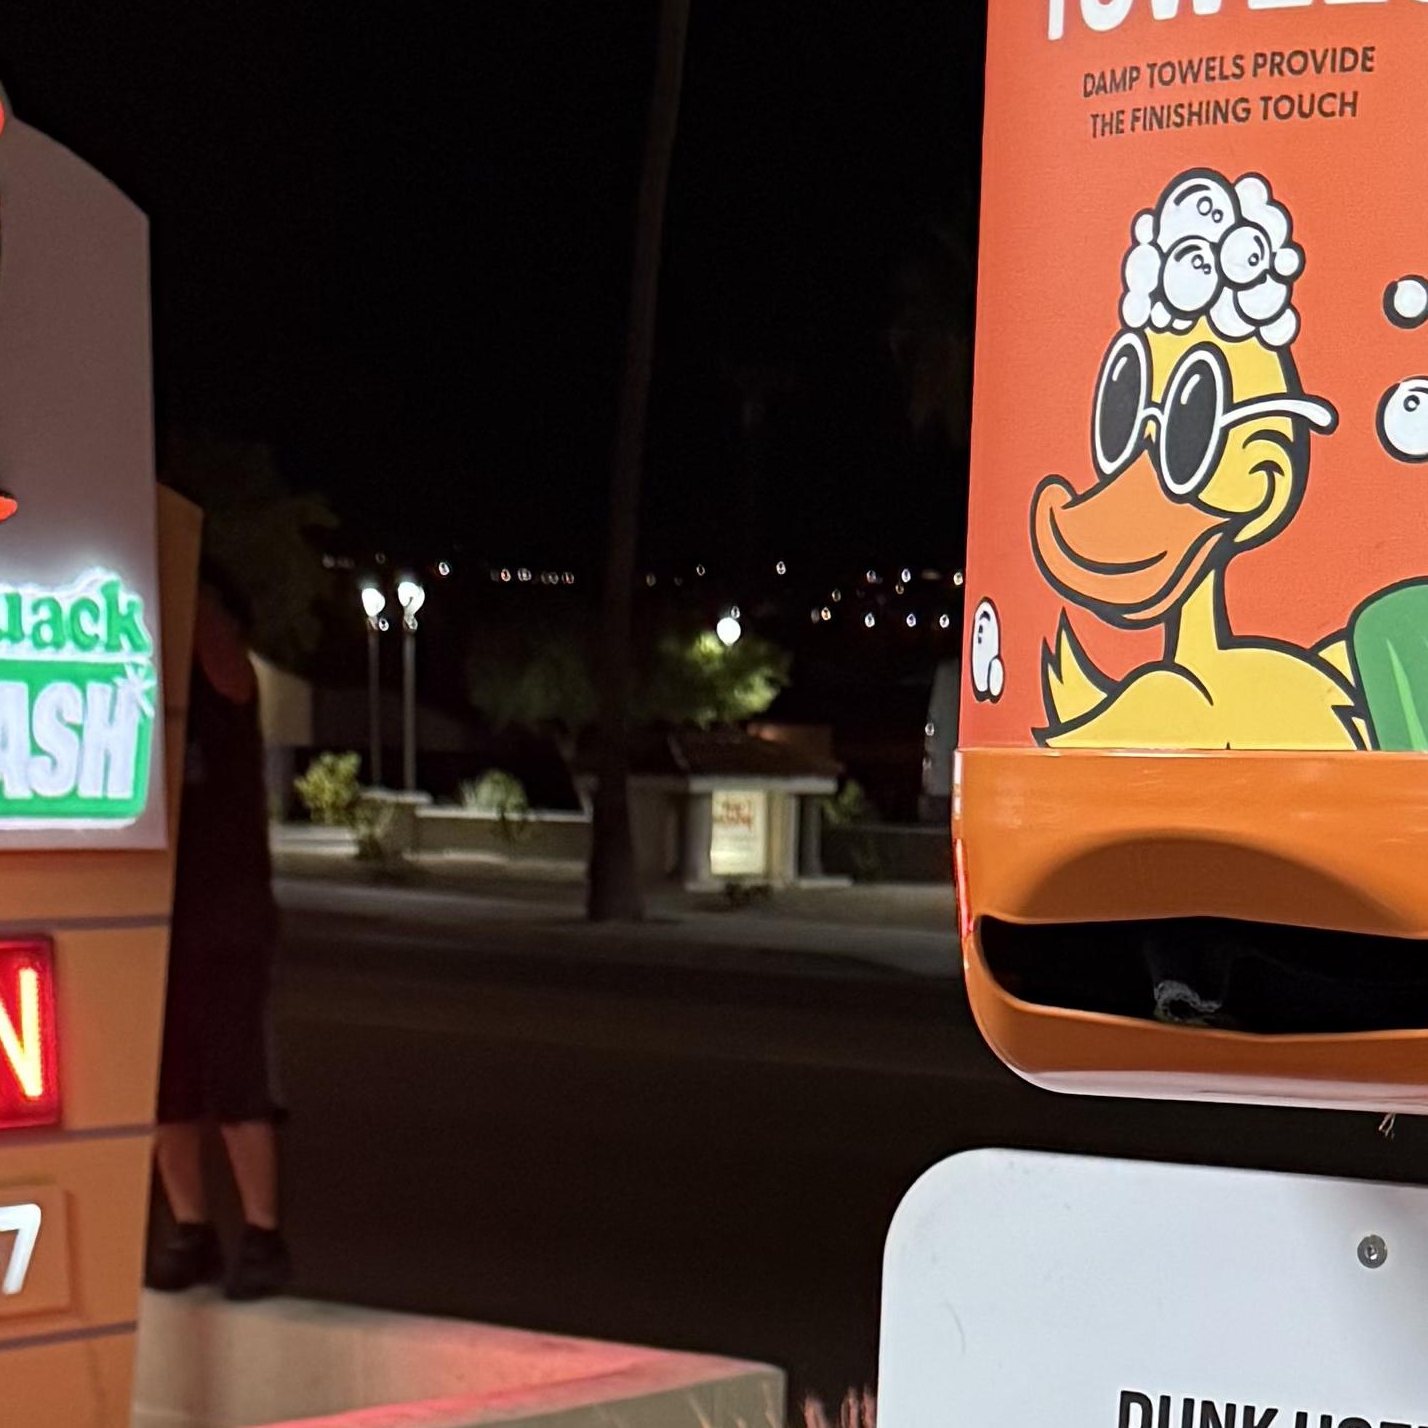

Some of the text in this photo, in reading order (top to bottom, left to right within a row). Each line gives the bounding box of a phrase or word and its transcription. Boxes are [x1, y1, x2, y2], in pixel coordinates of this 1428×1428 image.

[1083, 45, 1376, 98] DAMP TOWELS PROVIDE
[1090, 90, 1359, 139] THE FINISHING TOUCH
